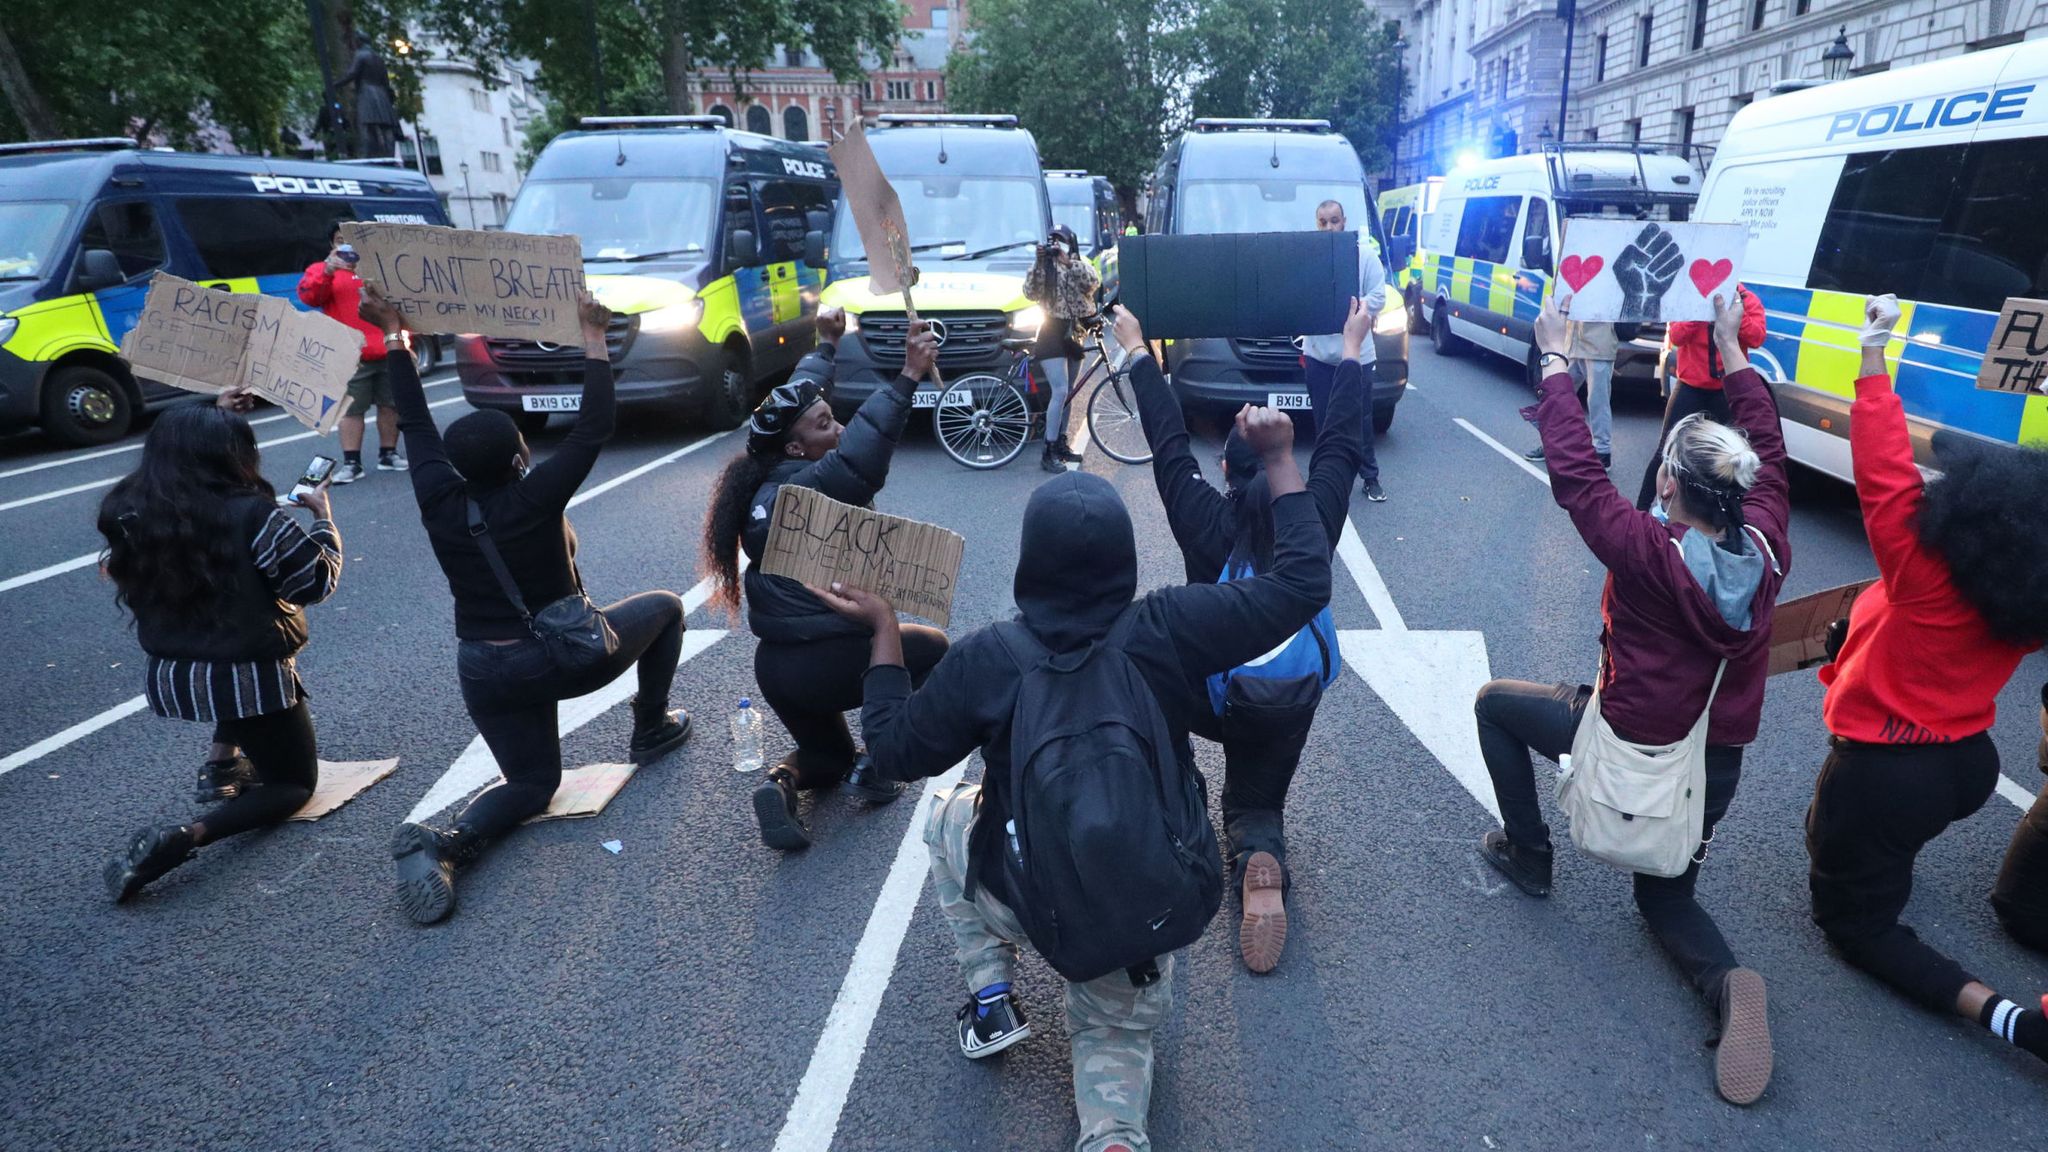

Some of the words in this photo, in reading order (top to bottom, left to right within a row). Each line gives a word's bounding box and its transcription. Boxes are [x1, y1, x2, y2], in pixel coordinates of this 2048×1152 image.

[1825, 84, 2036, 142] POLICE
[781, 157, 827, 179] POLICE
[251, 176, 364, 195] POLICE
[1464, 176, 1501, 192] POLICE
[1759, 208, 1775, 217] NOW
[436, 301, 466, 316] OFF
[475, 304, 498, 319] MY
[173, 287, 280, 341] RACISM
[299, 336, 336, 361] NOT
[531, 397, 558, 409] BX19
[912, 393, 937, 405] BX19
[945, 392, 964, 404] DA
[1276, 395, 1303, 407] BX19
[779, 492, 898, 556] BLACK
[1879, 715, 1951, 745] NAD
